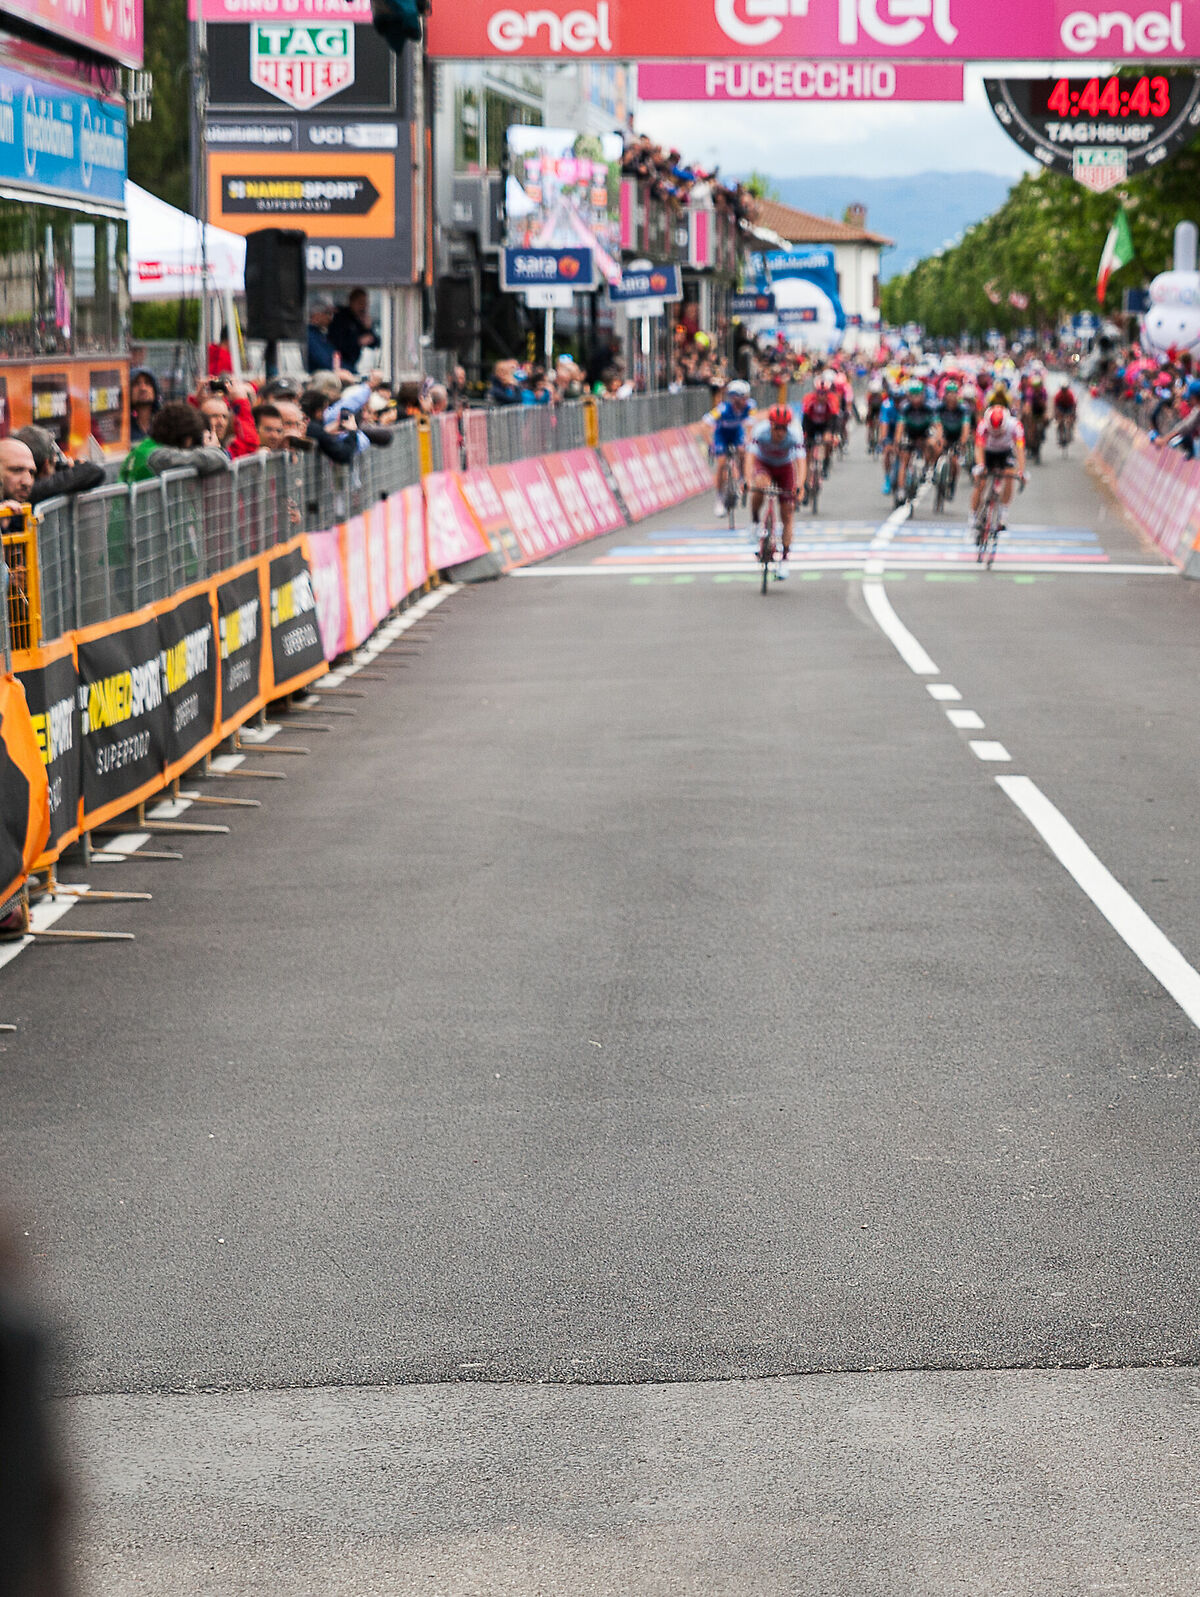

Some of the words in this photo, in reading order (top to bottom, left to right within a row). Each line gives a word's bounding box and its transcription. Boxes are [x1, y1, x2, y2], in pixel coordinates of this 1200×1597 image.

[260, 28, 345, 54] TAG
[487, 2, 612, 52] enel
[1060, 1, 1186, 53] enel
[705, 62, 897, 99] FUCECCHIO
[1047, 76, 1171, 117] 4:44:43
